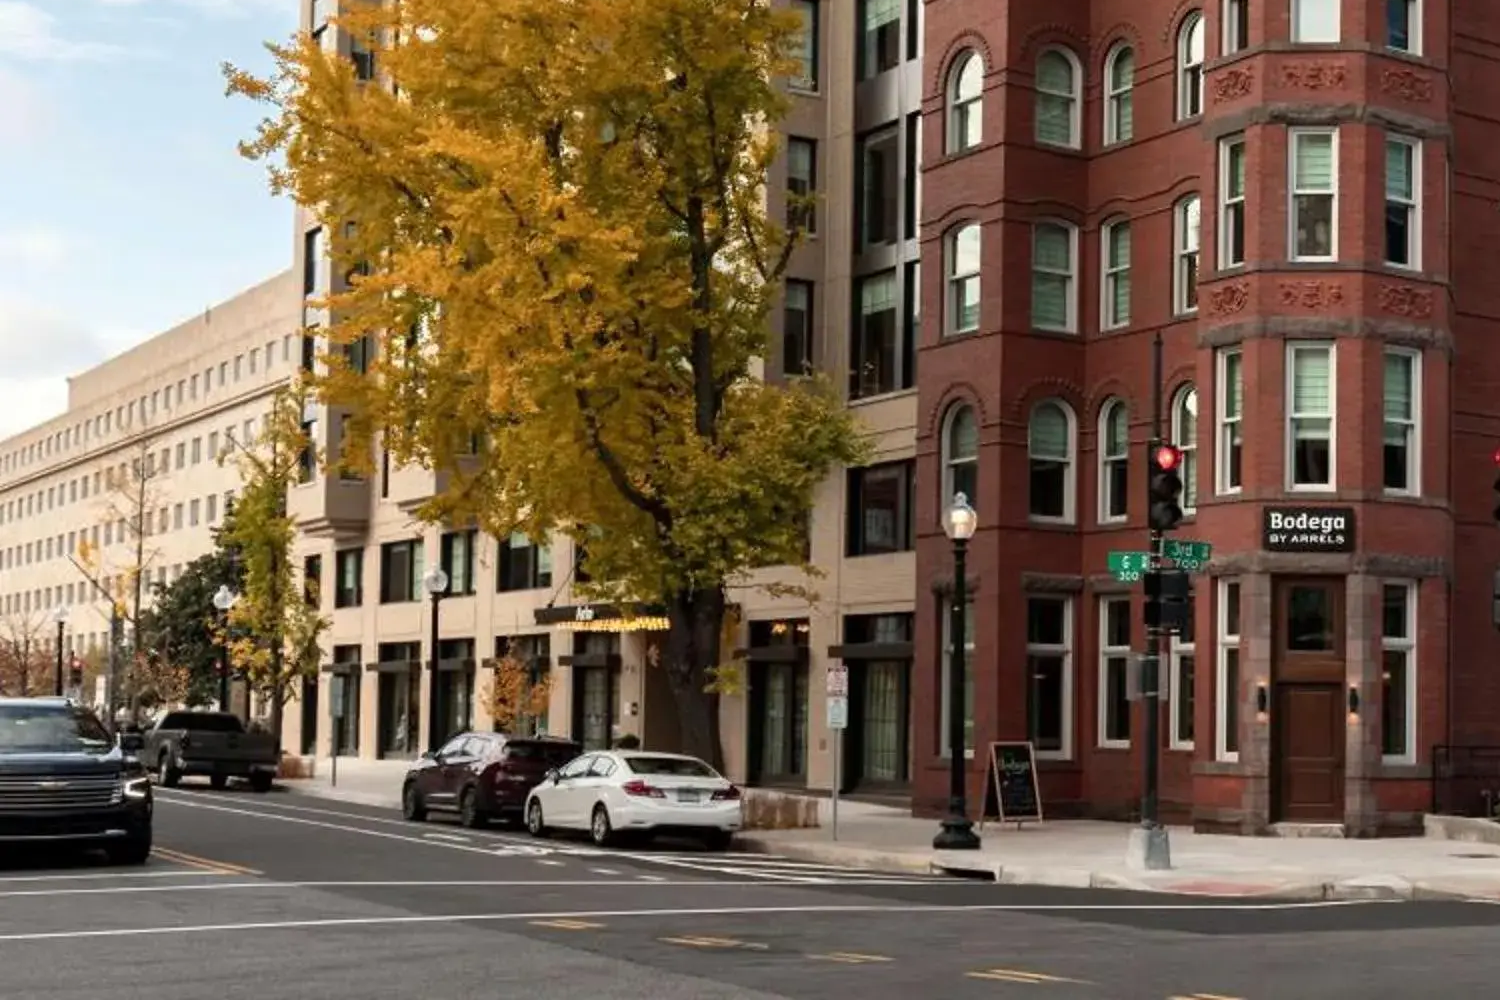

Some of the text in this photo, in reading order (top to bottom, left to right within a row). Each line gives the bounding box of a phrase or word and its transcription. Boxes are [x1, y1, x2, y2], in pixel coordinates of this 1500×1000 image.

[1269, 512, 1345, 534] Bodega
[1269, 534, 1345, 544] BY ARRELS
